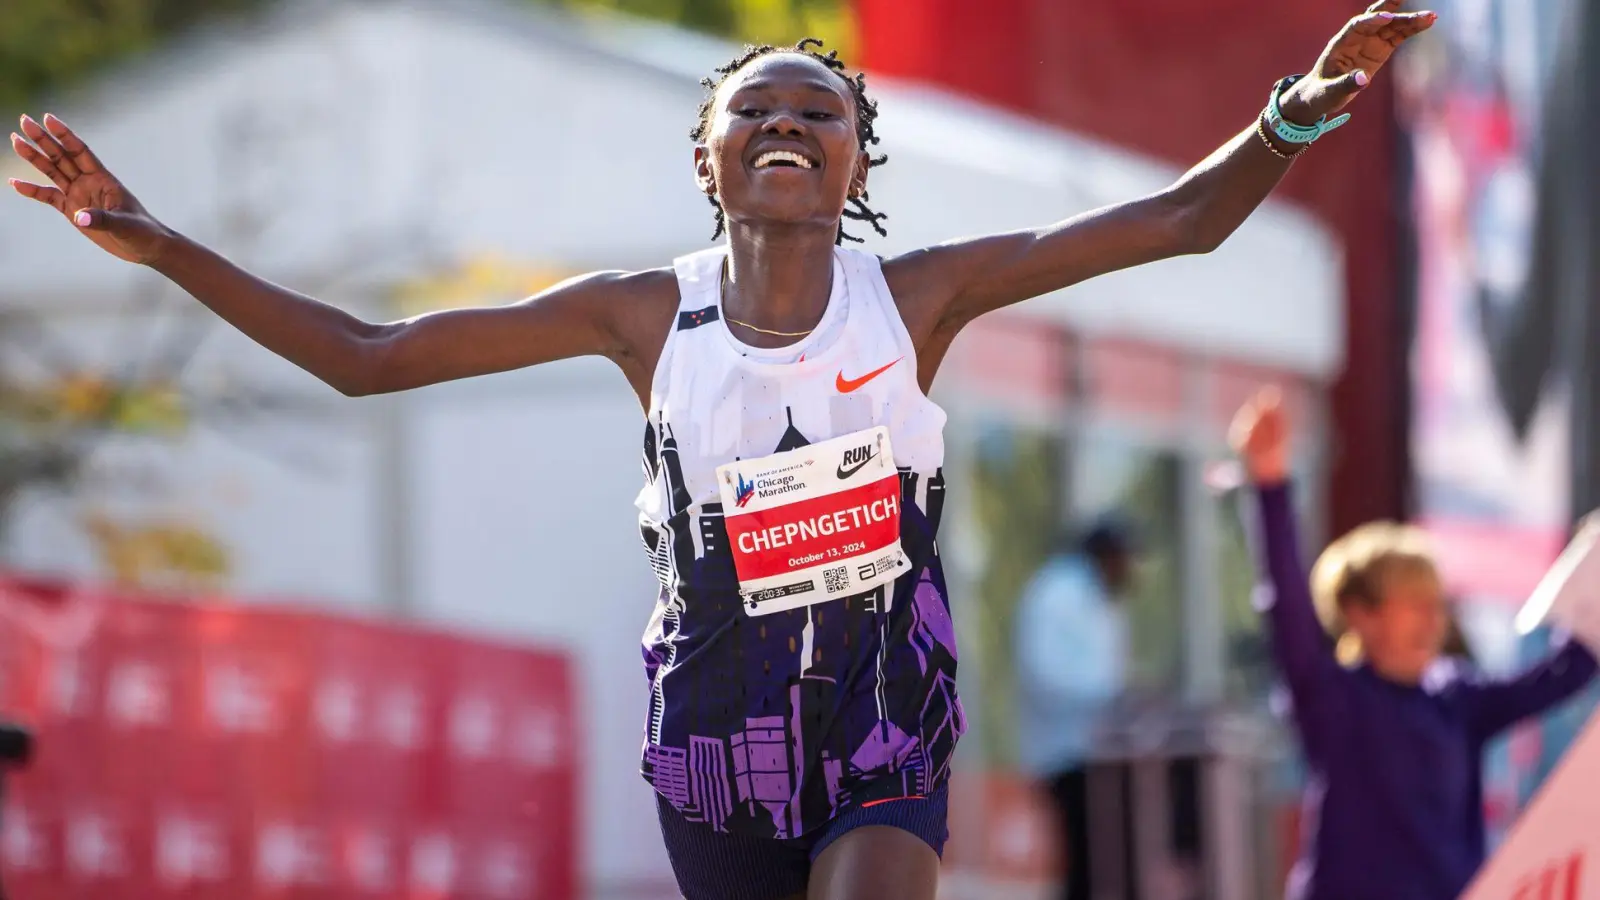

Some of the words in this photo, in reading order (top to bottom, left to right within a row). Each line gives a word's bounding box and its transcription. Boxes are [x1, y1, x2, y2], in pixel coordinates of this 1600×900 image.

[843, 444, 872, 466] RUN
[778, 463, 804, 474] AMERICA
[757, 474, 795, 490] Chicago
[758, 481, 806, 499] Marathon
[738, 495, 898, 554] CHEPNGETICH
[788, 551, 824, 567] October
[826, 546, 841, 558] 13,
[843, 541, 866, 555] 2024
